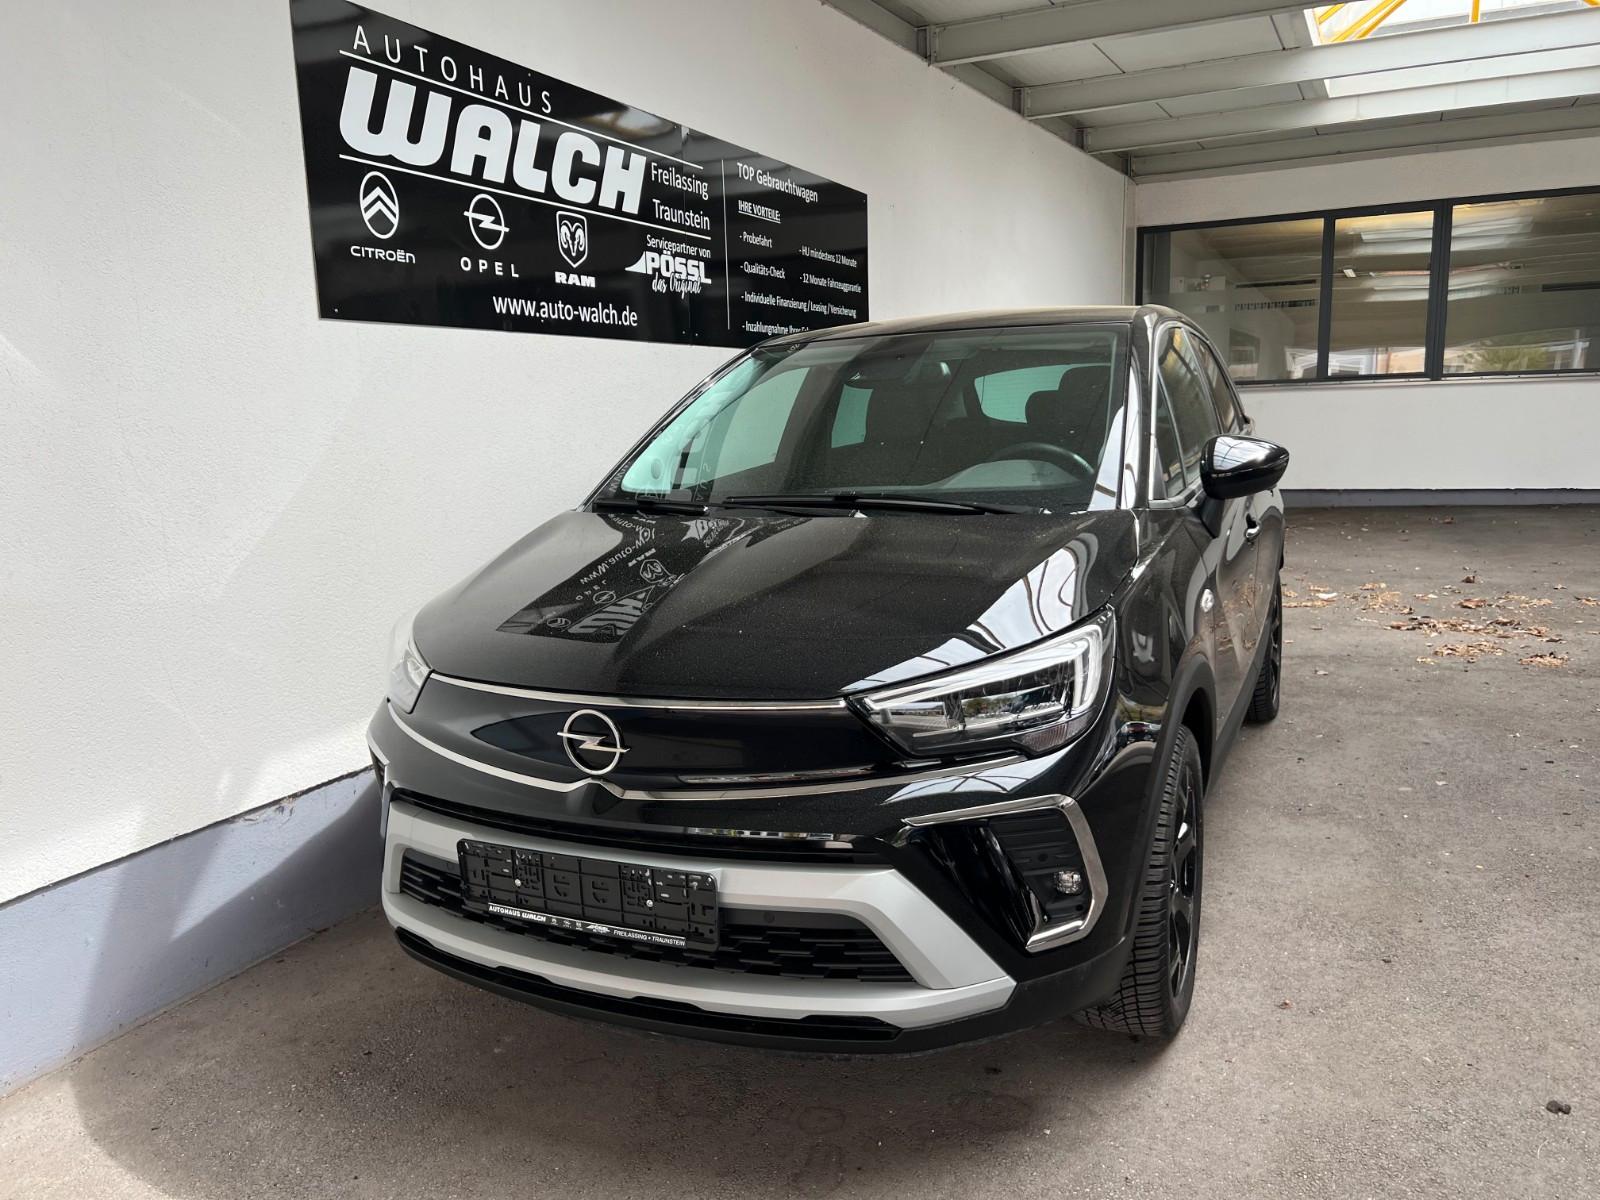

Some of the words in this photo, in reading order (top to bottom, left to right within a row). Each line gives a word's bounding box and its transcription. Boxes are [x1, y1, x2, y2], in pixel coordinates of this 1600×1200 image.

[353, 25, 552, 114] AUTOHAUS
[339, 66, 647, 215] WALCH
[651, 162, 709, 200] Freilassing
[737, 162, 754, 181] TOP
[756, 170, 818, 203] Gebrauchtwagen
[652, 198, 710, 231] Traunstein
[738, 200, 752, 214] IHRE
[753, 204, 781, 221] VORTEILE:
[646, 234, 698, 256] Servicepartner
[698, 247, 711, 259] von
[743, 231, 772, 248] Probefahrt
[460, 257, 519, 278] OPEL
[646, 249, 711, 284] PÖSSL
[802, 245, 810, 257] HU
[810, 248, 835, 263] mindestens
[835, 254, 841, 264] 12
[841, 255, 857, 268] Monate
[555, 271, 596, 289] RAM
[652, 271, 667, 293] das
[743, 261, 785, 279] Qualitäts-Check
[803, 273, 809, 284] 12
[810, 274, 826, 287] Monate
[492, 296, 638, 327] www.auto-walch.de
[744, 291, 776, 306] Individuelle
[776, 296, 807, 312] Finanzierung
[810, 302, 828, 315] Leasing
[830, 304, 857, 319] Versicherung
[745, 321, 788, 336] Inzahlungnahme
[488, 905, 521, 917] AUTOHAUS
[613, 930, 648, 941] FREILASSING
[652, 936, 686, 947] TRAUNSTEIN
